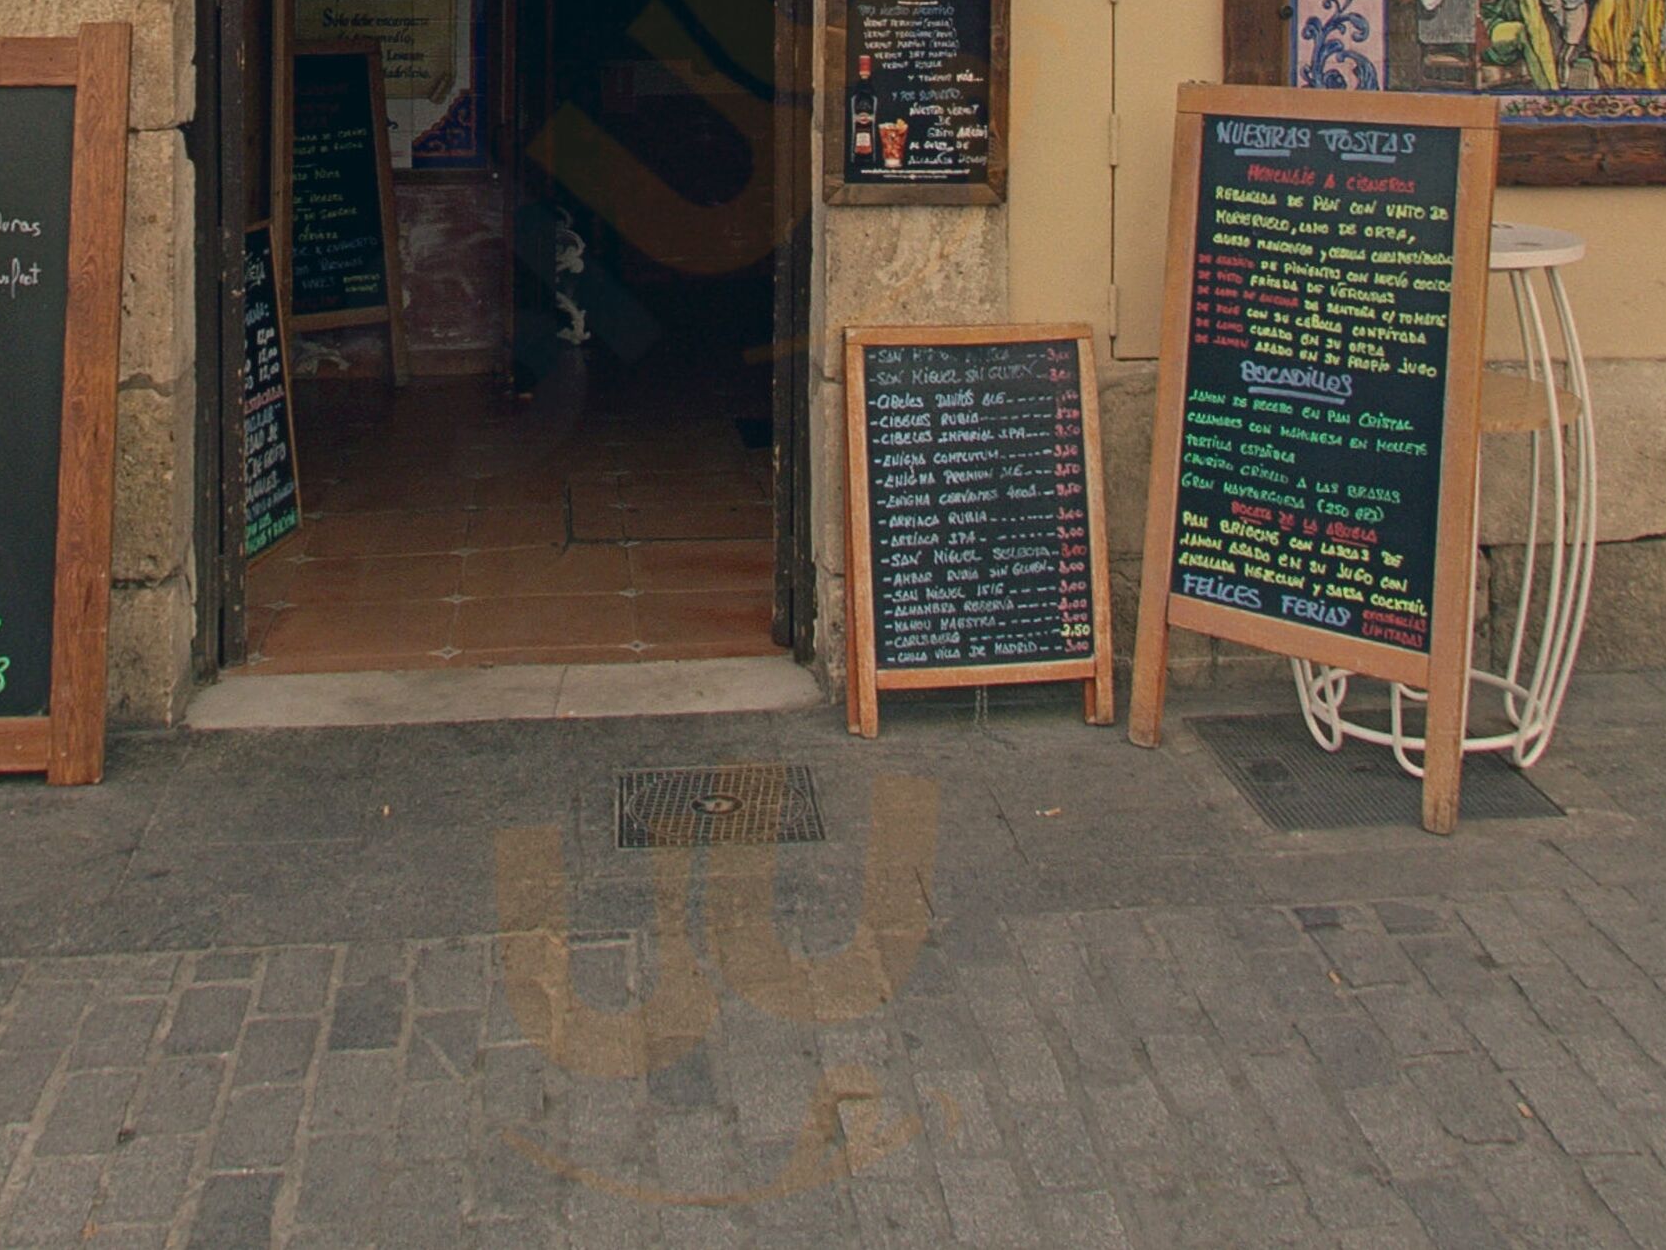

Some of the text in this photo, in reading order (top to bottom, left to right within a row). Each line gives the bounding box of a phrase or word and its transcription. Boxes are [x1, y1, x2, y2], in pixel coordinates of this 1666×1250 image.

[1216, 120, 1417, 155] NUESTRAS TOSTAS
[1247, 163, 1337, 190] HOMENAJE A
[1287, 194, 1304, 208] DE
[1312, 193, 1342, 213] PAN
[1349, 200, 1377, 216] CON
[1338, 222, 1358, 237] DE
[1346, 270, 1369, 284] CON
[1246, 306, 1268, 320] CON
[1249, 323, 1342, 351] CURADO EN SU
[1254, 340, 1294, 358] ASADO
[1299, 349, 1318, 363] EN
[1347, 354, 1391, 373] PROPIO
[1397, 357, 1438, 378] JUGO
[1239, 359, 1354, 397] BOCADILLOS
[878, 410, 979, 429] CIBELES RUBIA
[1301, 406, 1415, 432] EN PAN CRISTAL
[880, 429, 933, 447] CIBELES
[1185, 433, 1233, 452] TORTILLA
[1248, 422, 1369, 451] CON EN
[882, 450, 927, 468] ENIGMA
[883, 468, 936, 489] ENIGMA
[1181, 472, 1216, 491] GRAN
[885, 492, 931, 509] ENIGMA
[1295, 477, 1401, 505] A LAS BRASAS
[887, 510, 988, 529] ARRIACA RUBIA
[1302, 518, 1318, 532] LA
[889, 531, 940, 547] ARRIACA
[1182, 510, 1371, 562] PAN CON LASCAS
[890, 547, 983, 567] SAN MIGUEL
[1180, 532, 1409, 594] JAMON ASADO EN SU JUGO CON
[946, 567, 979, 583] RUBIA
[1178, 551, 1429, 617] ENSALADA SALSA COCKTAIL
[891, 588, 919, 603] SAN
[925, 584, 966, 600] MIGUEL
[1182, 572, 1352, 628] FELICES FERIAS
[893, 601, 957, 616] ALHAMBRA
[894, 617, 932, 633] MAHOU
[994, 640, 1038, 656] MADRID
